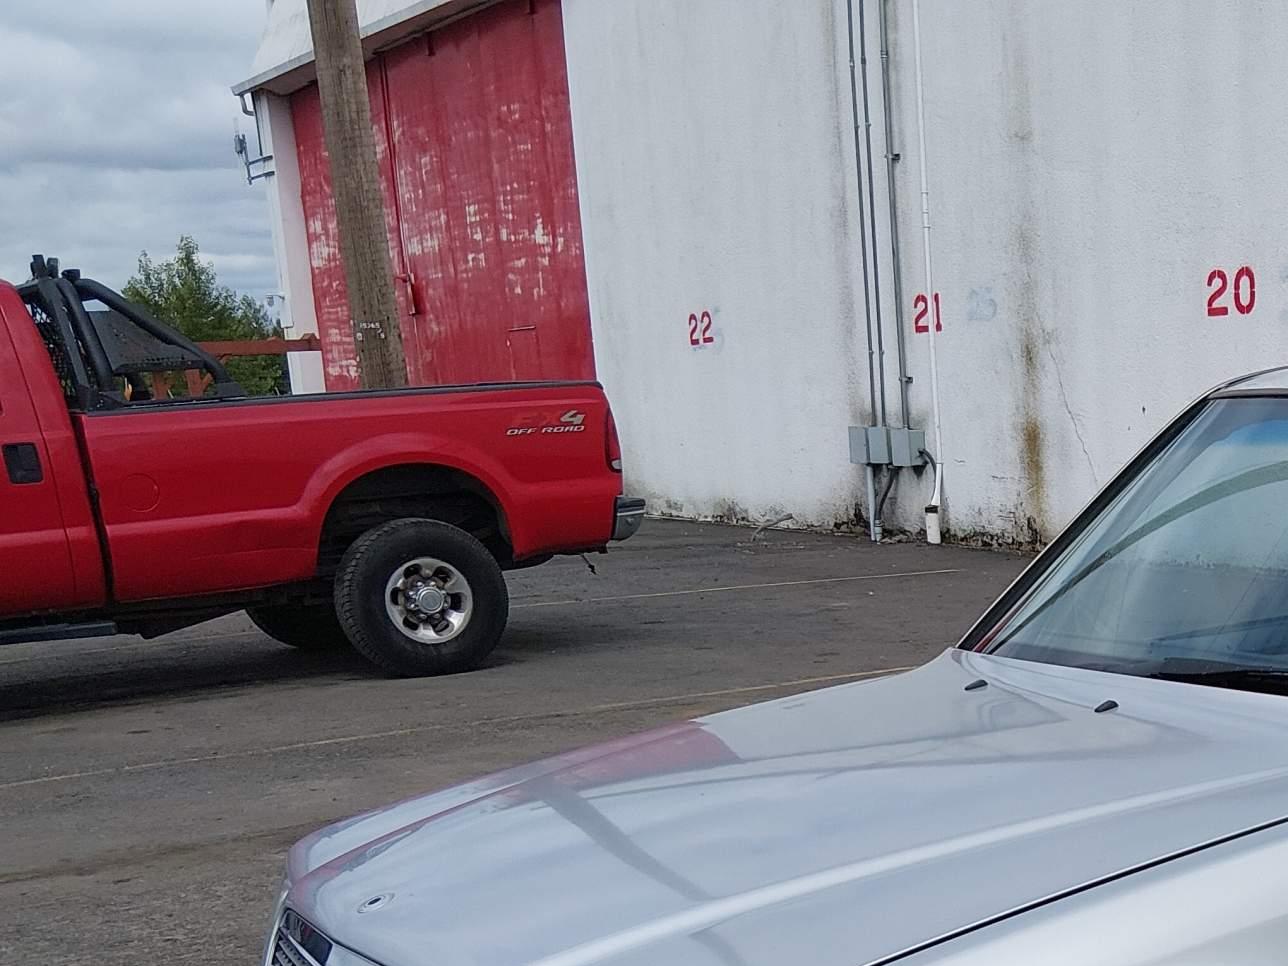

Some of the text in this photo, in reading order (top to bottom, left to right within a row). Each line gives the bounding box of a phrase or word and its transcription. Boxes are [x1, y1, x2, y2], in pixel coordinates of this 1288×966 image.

[1206, 266, 1256, 316] 20
[688, 311, 714, 346] 22
[913, 292, 942, 333] 21
[506, 425, 585, 436] OFF ROAD
